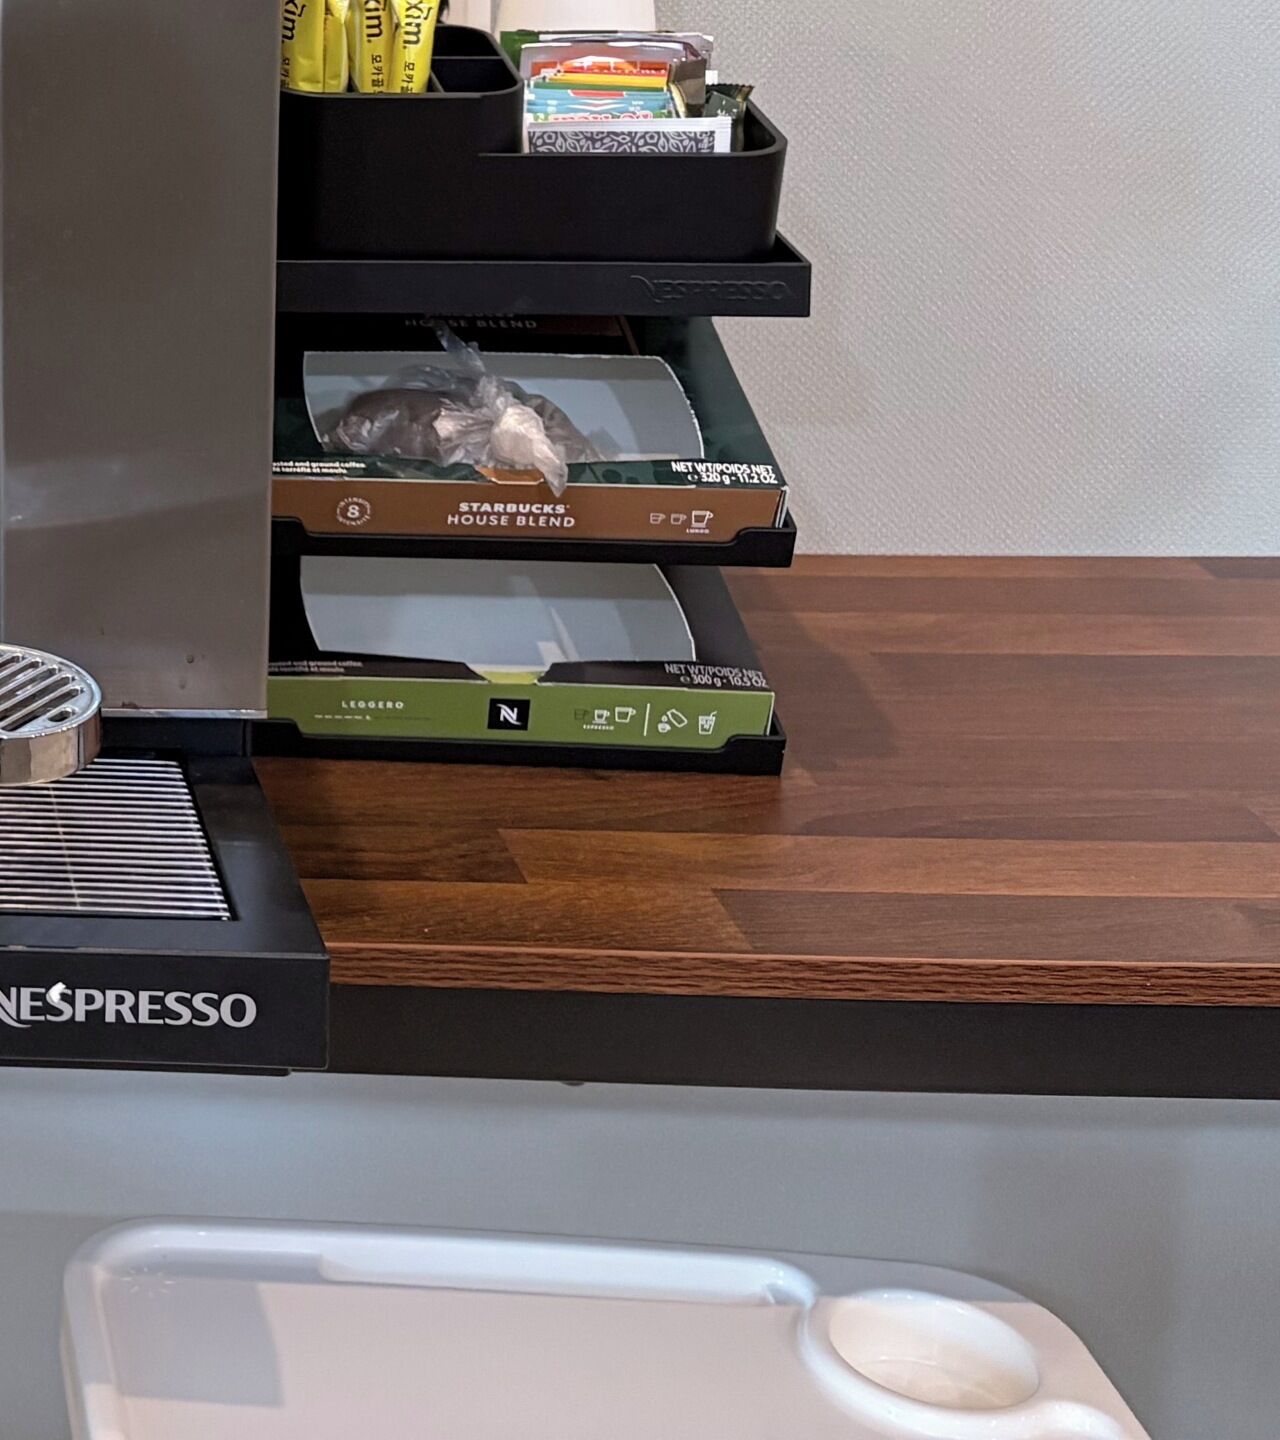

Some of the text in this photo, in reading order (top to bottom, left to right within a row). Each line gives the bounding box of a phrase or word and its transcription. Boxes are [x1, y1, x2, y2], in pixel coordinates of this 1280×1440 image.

[671, 461, 773, 475] NET WT/POIDS NET
[700, 472, 720, 482] 320
[722, 474, 730, 485] g
[347, 504, 360, 518] 8
[458, 502, 567, 515] STARBUCKS
[447, 514, 576, 528] HOUSE BLEND
[664, 663, 764, 680] NET WT/POIDS NET
[692, 674, 712, 684] 300
[713, 677, 722, 687] g
[341, 700, 404, 710] LEGGERO
